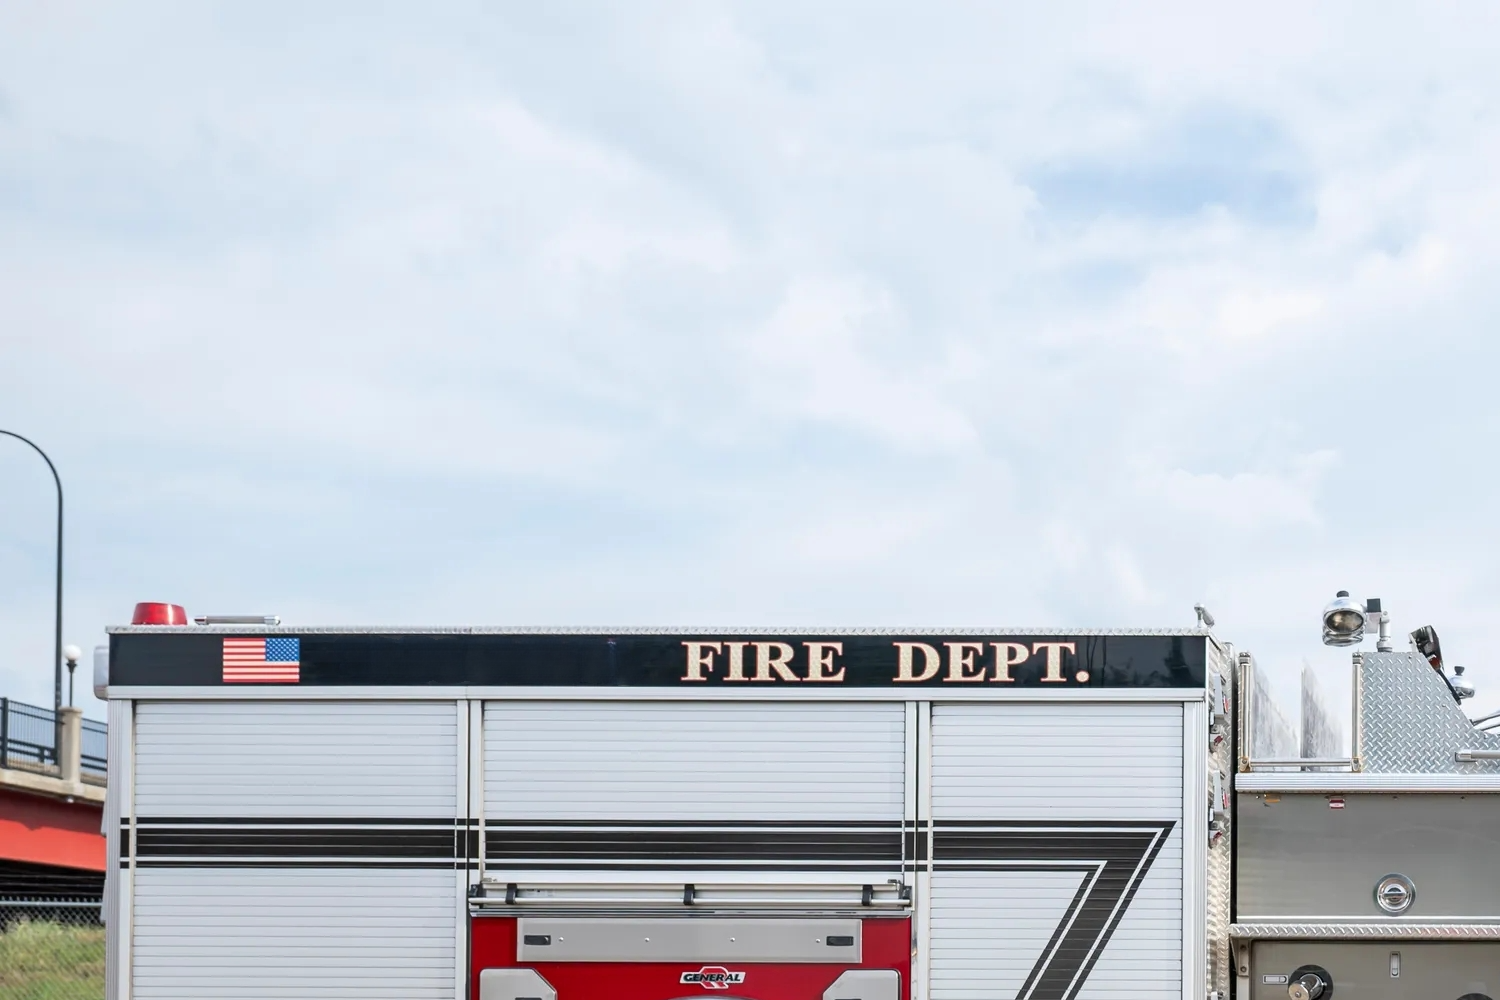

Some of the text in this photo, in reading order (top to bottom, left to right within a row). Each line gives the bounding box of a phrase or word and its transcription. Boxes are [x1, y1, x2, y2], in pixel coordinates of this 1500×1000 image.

[680, 641, 1090, 683] FIRE DEPT.
[683, 973, 741, 982] GENERAL
